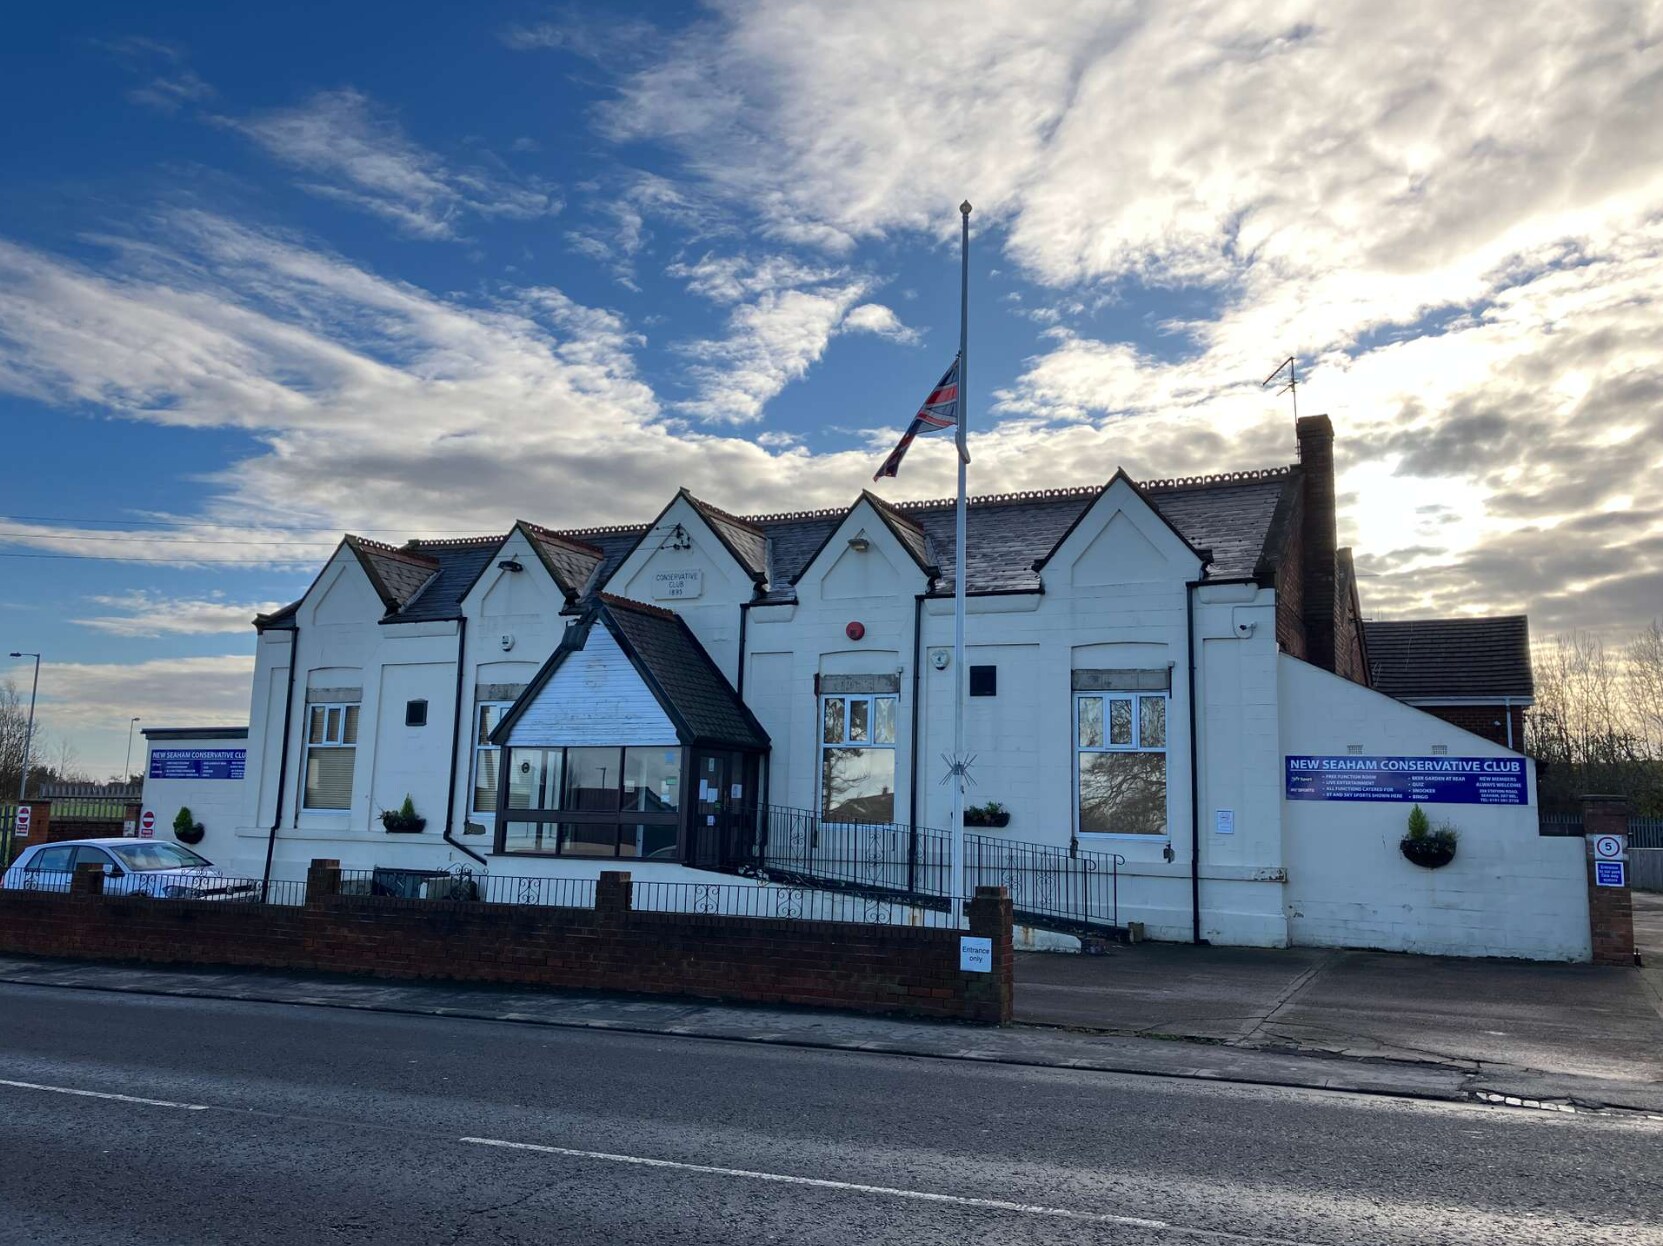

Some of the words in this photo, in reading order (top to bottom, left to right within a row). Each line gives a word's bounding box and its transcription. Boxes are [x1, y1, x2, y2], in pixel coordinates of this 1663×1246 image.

[656, 572, 697, 581] CONSERVATIVE
[1290, 760, 1319, 769] NEW
[1322, 760, 1378, 770] SEAHAM
[1380, 760, 1480, 771] CONSERVATIVE
[1484, 761, 1520, 772] CLUB
[1605, 842, 1612, 851] 5
[962, 946, 990, 954] Entrance
